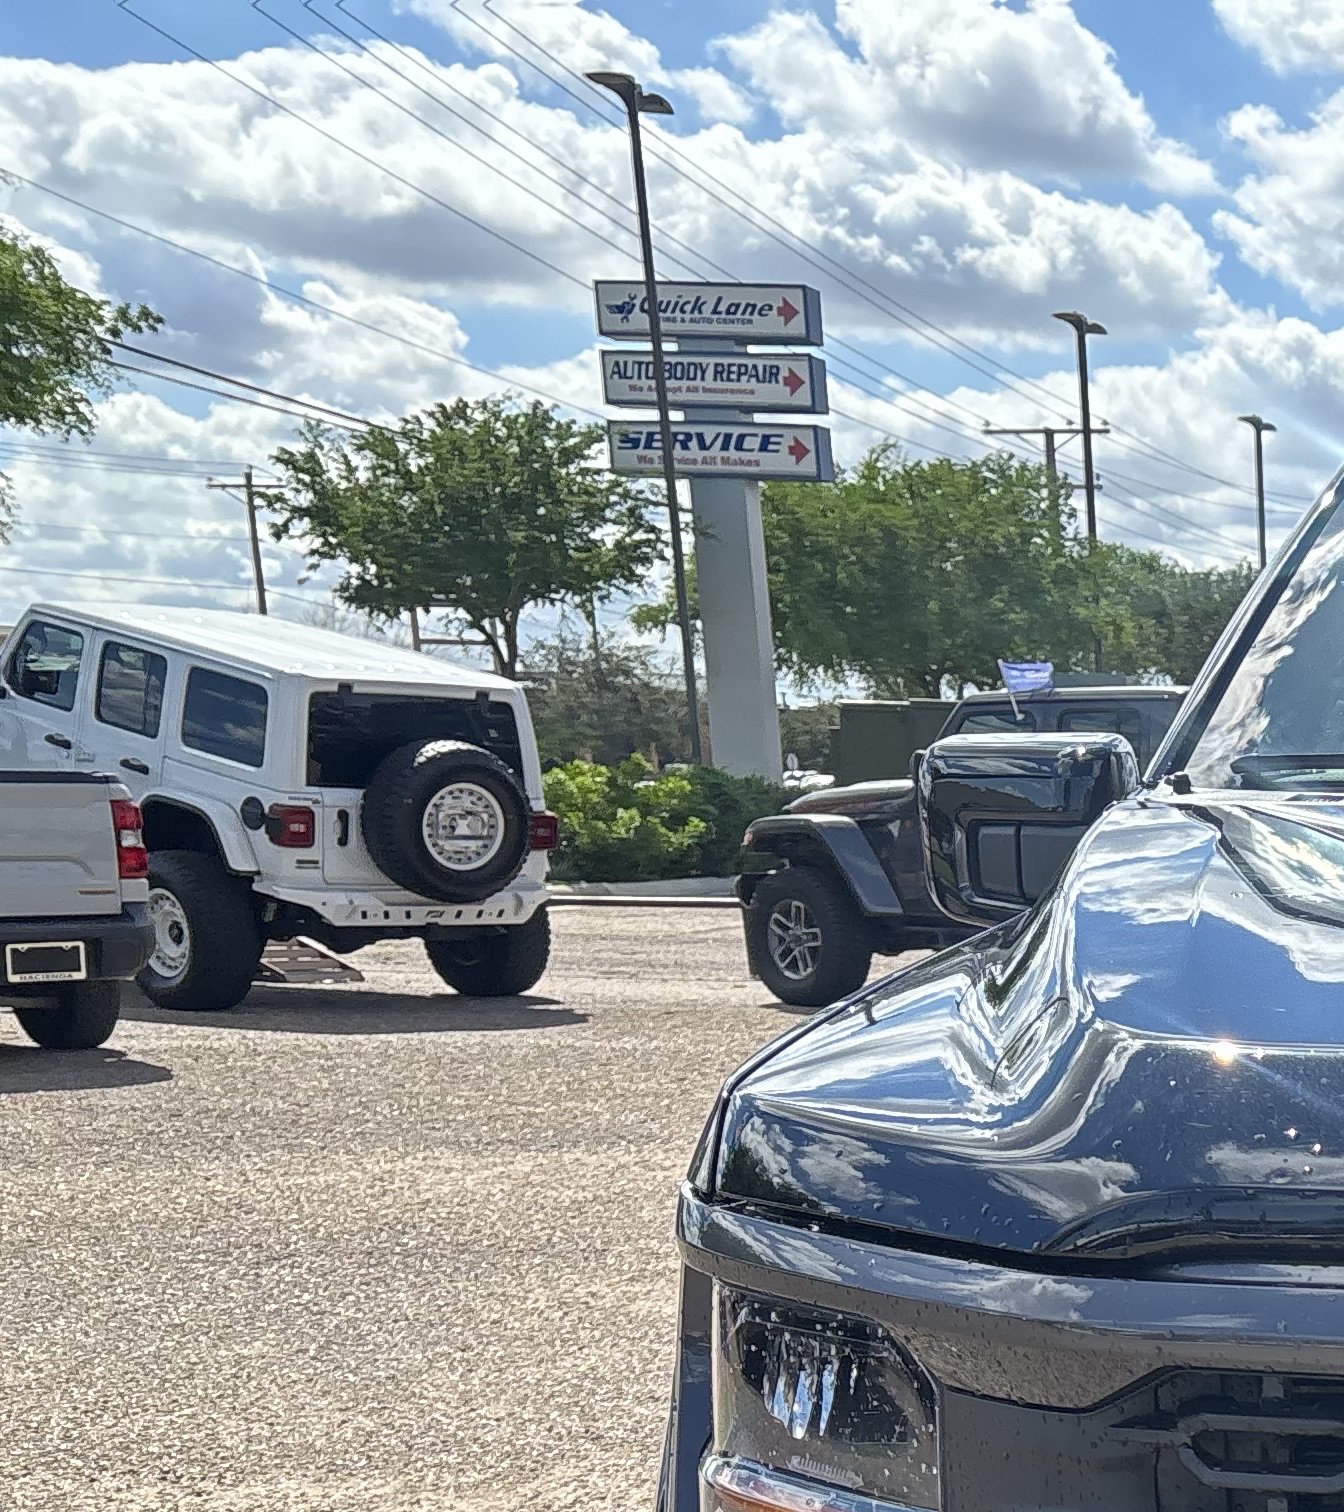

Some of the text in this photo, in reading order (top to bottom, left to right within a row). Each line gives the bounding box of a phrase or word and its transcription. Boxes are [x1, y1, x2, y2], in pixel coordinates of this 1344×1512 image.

[710, 295, 773, 317] Lane
[610, 360, 780, 384] AUTO BODY REPAIR
[617, 431, 784, 454] SERVICE
